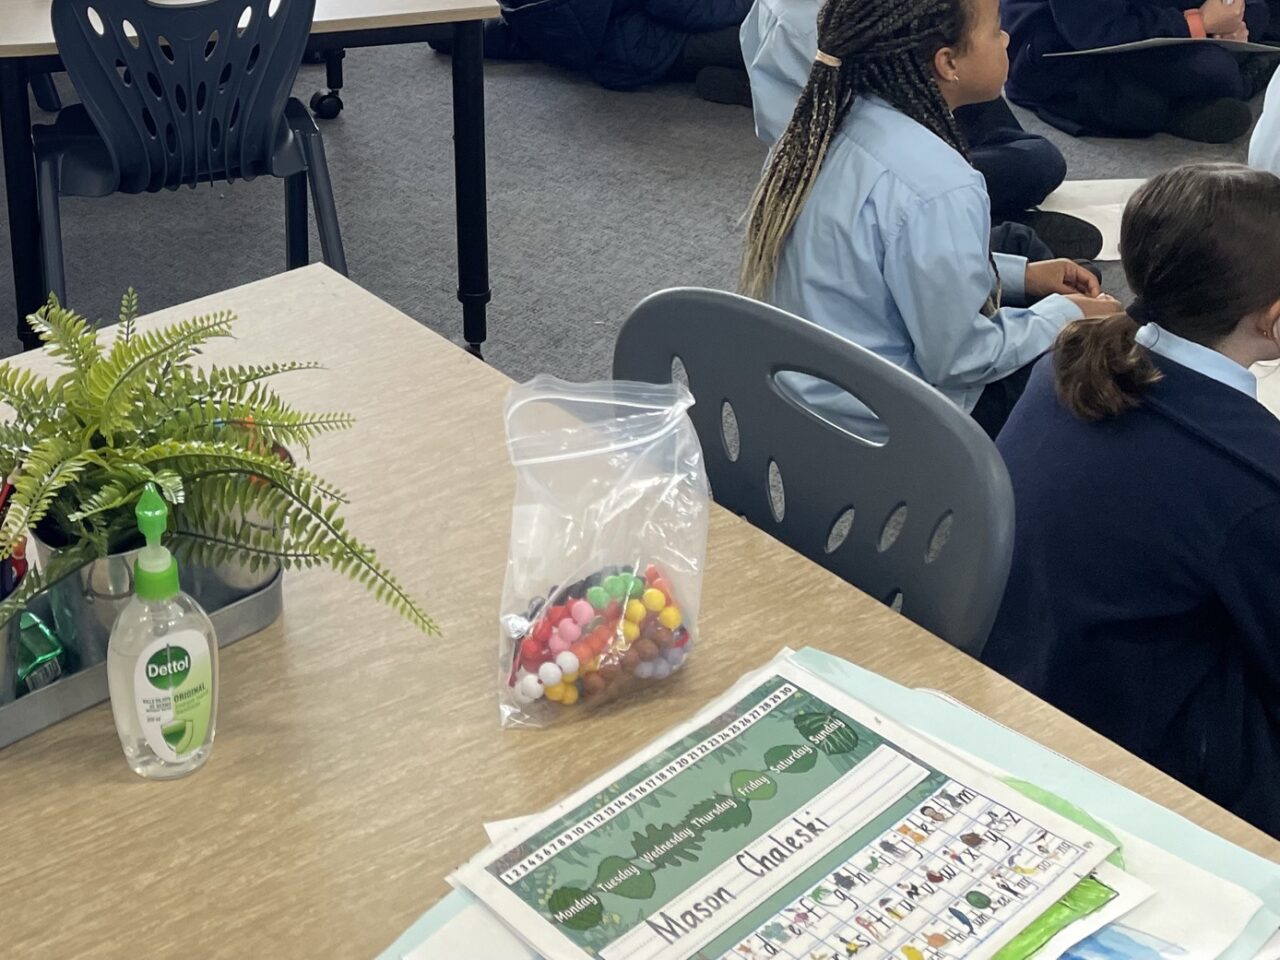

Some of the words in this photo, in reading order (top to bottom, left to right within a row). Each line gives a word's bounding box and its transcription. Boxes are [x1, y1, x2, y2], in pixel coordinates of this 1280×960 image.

[148, 655, 189, 678] Dettol
[173, 681, 206, 704] ORIGINAL
[572, 827, 584, 836] 10
[584, 821, 594, 829] 11
[594, 814, 605, 823] 12
[604, 807, 616, 816] 13
[614, 800, 626, 809] 14
[625, 792, 637, 801] 15
[635, 786, 647, 795] 16
[646, 780, 656, 788] 17
[656, 773, 667, 782] 18
[666, 766, 677, 774] 19
[676, 758, 689, 767] 20
[688, 751, 699, 760] 21
[697, 744, 709, 753] 22
[708, 737, 721, 746] 23
[720, 732, 731, 740] 24
[730, 724, 741, 734] 25
[739, 718, 752, 727] 26
[750, 710, 761, 719] 27
[759, 702, 771, 712] 28
[771, 695, 782, 704] 29
[781, 686, 792, 696] 30
[956, 788, 977, 805] m
[554, 893, 598, 923] Monday
[597, 865, 640, 892] Tuesday
[640, 826, 696, 864] Wednesday
[690, 797, 738, 829] Thursday
[737, 775, 771, 796] Friday
[769, 743, 813, 774] Saturday
[809, 718, 846, 744] Sunday
[906, 818, 935, 837] k
[645, 886, 737, 945] Mason
[735, 811, 830, 878] Chaleski
[842, 867, 870, 886] h
[856, 935, 870, 948] s
[866, 910, 892, 930] t
[900, 900, 916, 913] u
[920, 883, 935, 896] v
[941, 863, 958, 881] w
[962, 847, 981, 861] x
[984, 834, 1012, 851] y
[1005, 811, 1023, 825] z
[799, 898, 822, 919] f
[834, 889, 859, 910] g
[789, 924, 802, 936] e
[755, 933, 782, 955] d
